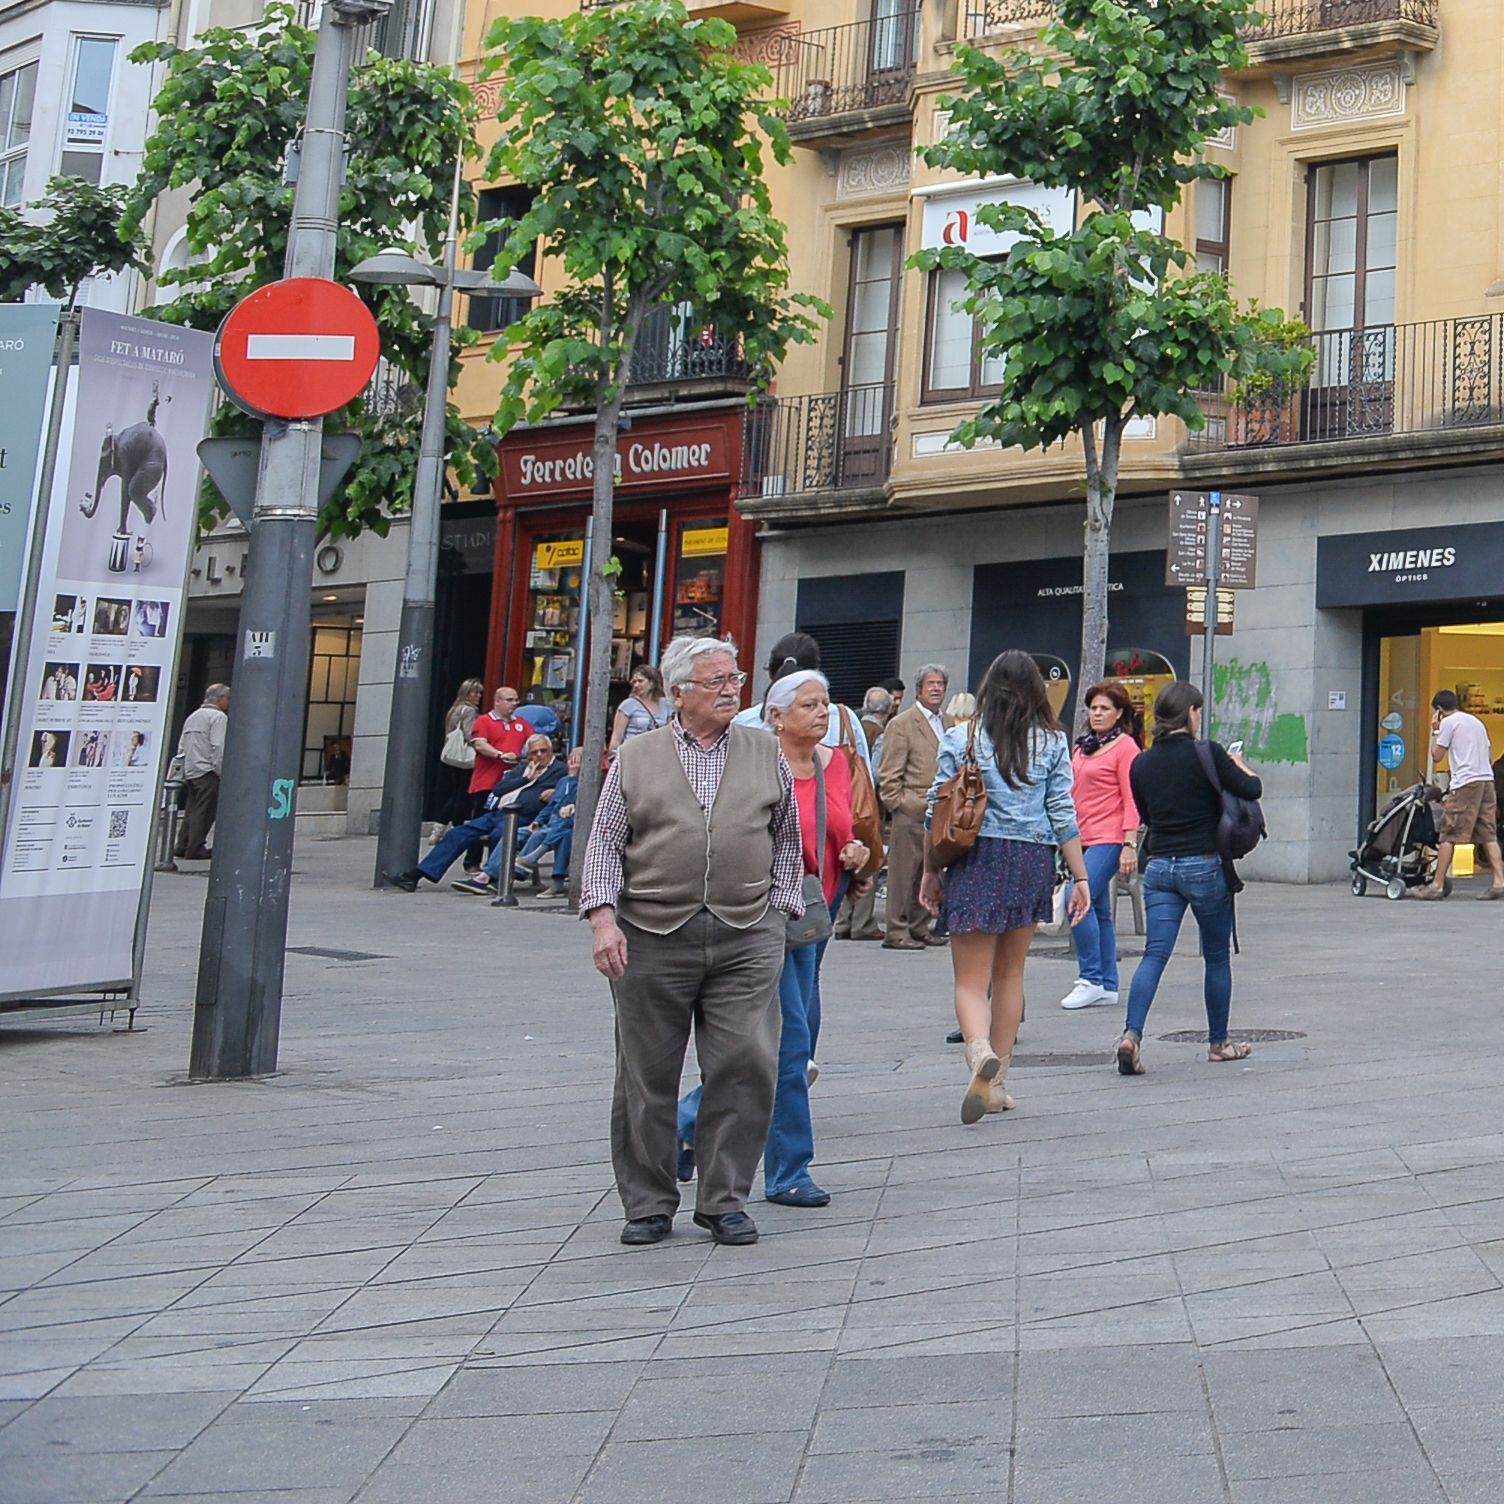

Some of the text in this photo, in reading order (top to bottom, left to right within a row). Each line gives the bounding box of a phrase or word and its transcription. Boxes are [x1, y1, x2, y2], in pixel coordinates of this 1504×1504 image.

[110, 340, 184, 365] FET A MATARÓ
[629, 442, 711, 473] Colomer
[1367, 547, 1456, 572] XIMENES
[1037, 588, 1054, 597] ALTA
